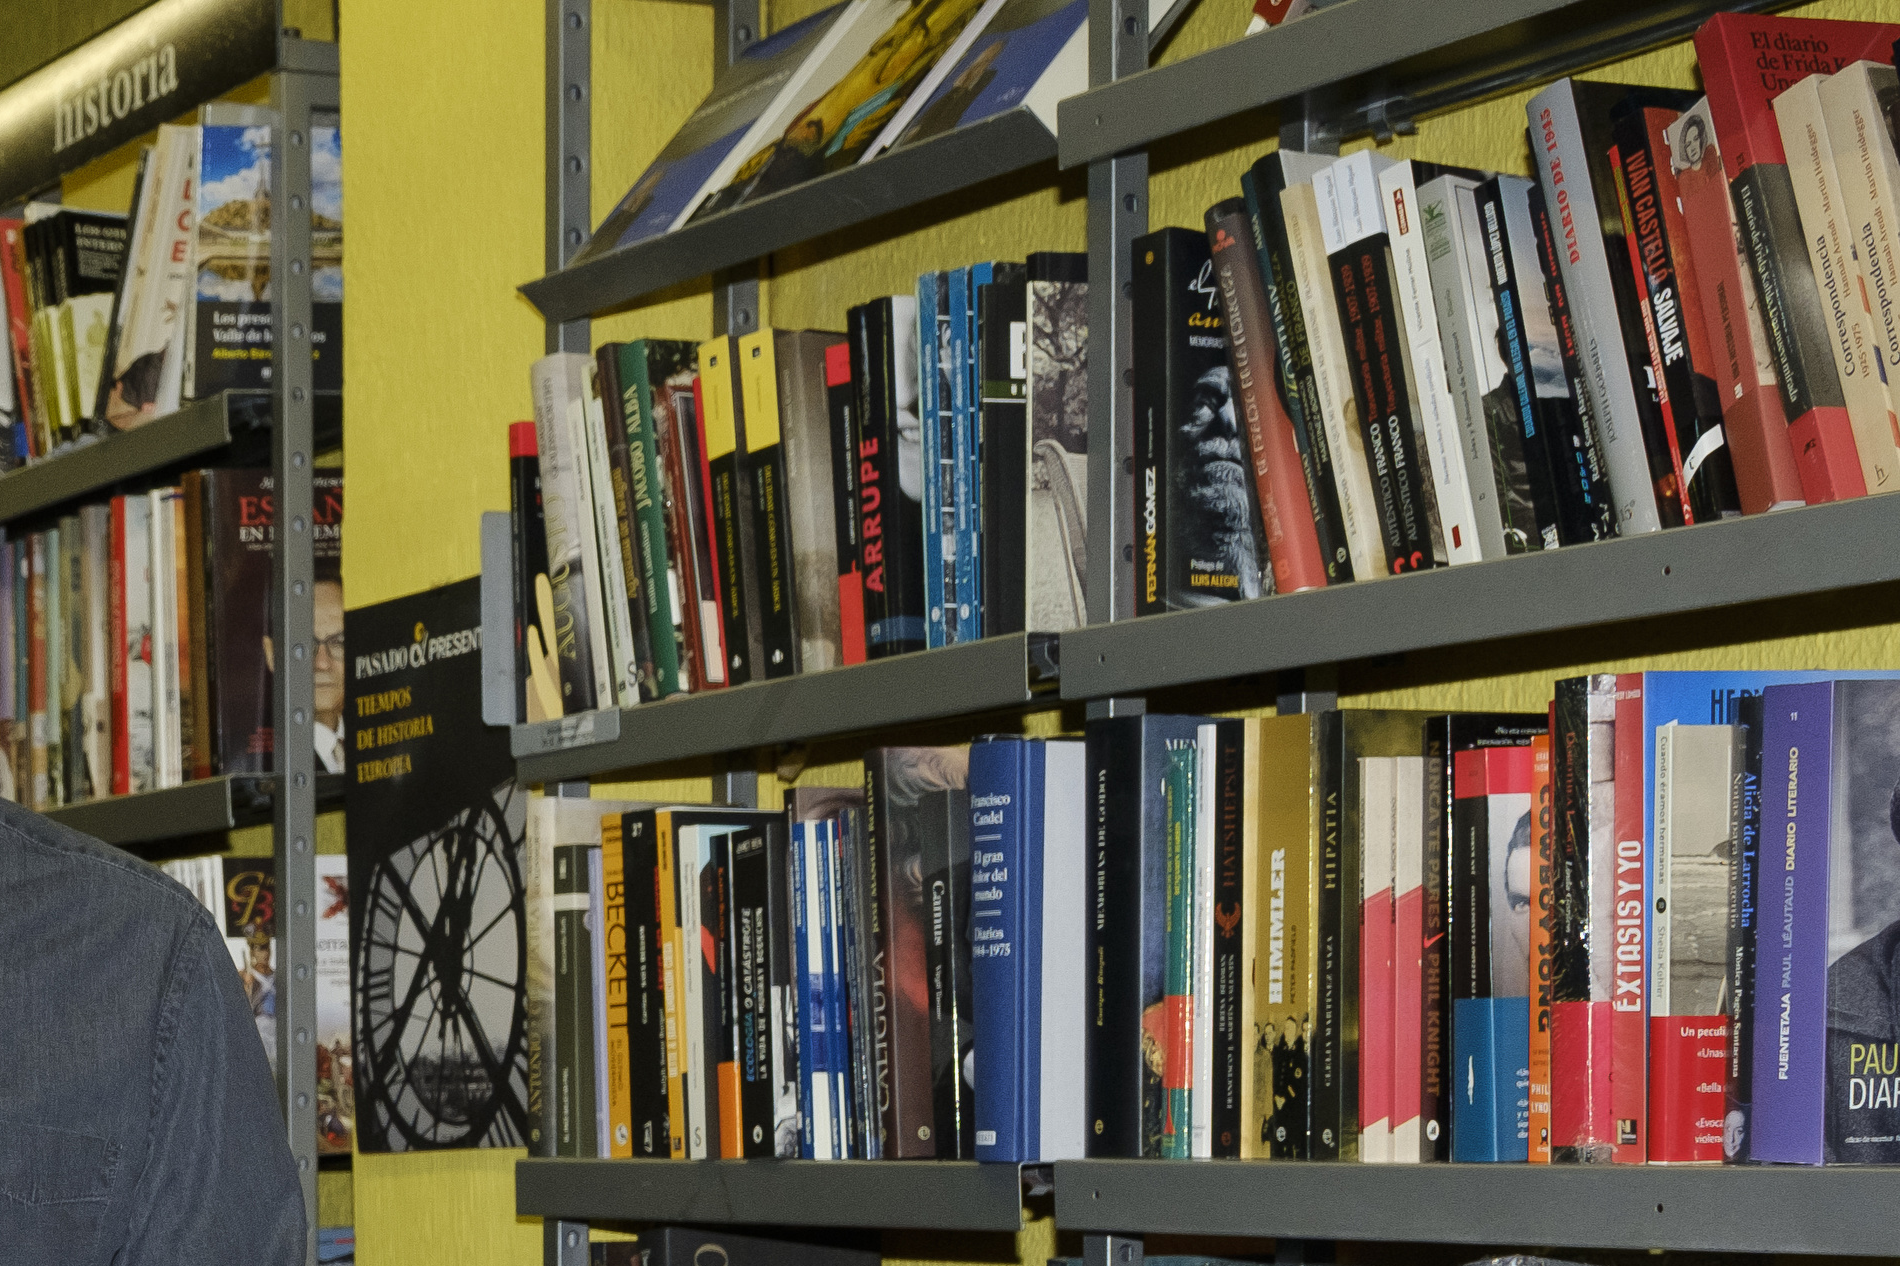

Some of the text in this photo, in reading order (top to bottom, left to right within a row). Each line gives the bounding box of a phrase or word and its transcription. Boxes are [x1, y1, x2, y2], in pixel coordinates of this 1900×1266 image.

[1751, 31, 1829, 53] El diario
[1756, 51, 1831, 73] de Frida
[53, 43, 179, 153] historia
[1540, 107, 1581, 266] DIARIO DE 1945
[1806, 122, 1851, 299] Hannah Arendt Martin Heidegger
[1626, 149, 1684, 367] IVÁN CASTELLÓ SALVAJE
[1816, 235, 1856, 378] Correspondencia
[1850, 322, 1870, 379] 1925-1975
[624, 383, 653, 512] JACOBO ALBA
[1601, 396, 1617, 444] JOSEPH
[859, 436, 884, 593] ARRUPE
[1388, 414, 1418, 541] AUTÉNTICO FRANCO
[355, 625, 482, 679] PASADO PRESENT
[355, 686, 412, 717] TIEMPOS
[356, 715, 434, 750] DE HISTORIA
[973, 811, 1004, 826] Candel
[1222, 745, 1237, 887] HATSHEPSUT
[1325, 791, 1337, 889] HIPATIA
[1659, 782, 1667, 826] éramos
[1741, 771, 1757, 928] Alicia de Larrocha
[1658, 829, 1666, 885] hermanas
[606, 880, 628, 1029] BECKETT
[741, 906, 753, 993] CATÁSTROFE
[932, 880, 944, 946] Camus
[1268, 846, 1286, 1005] HIMMLER
[1426, 740, 1440, 1098] NUNCA TE PARES PHIL KNIGHT
[1613, 839, 1642, 1012] ÉXTASIS Y YO
[1657, 926, 1665, 962] Sheila
[1778, 746, 1799, 1081] FUENTETAJA PAUL LÉAUTAUD DIARIO LITERARIO
[745, 1011, 756, 1082] ECOLOGÍA
[1850, 1043, 1899, 1075] PAU
